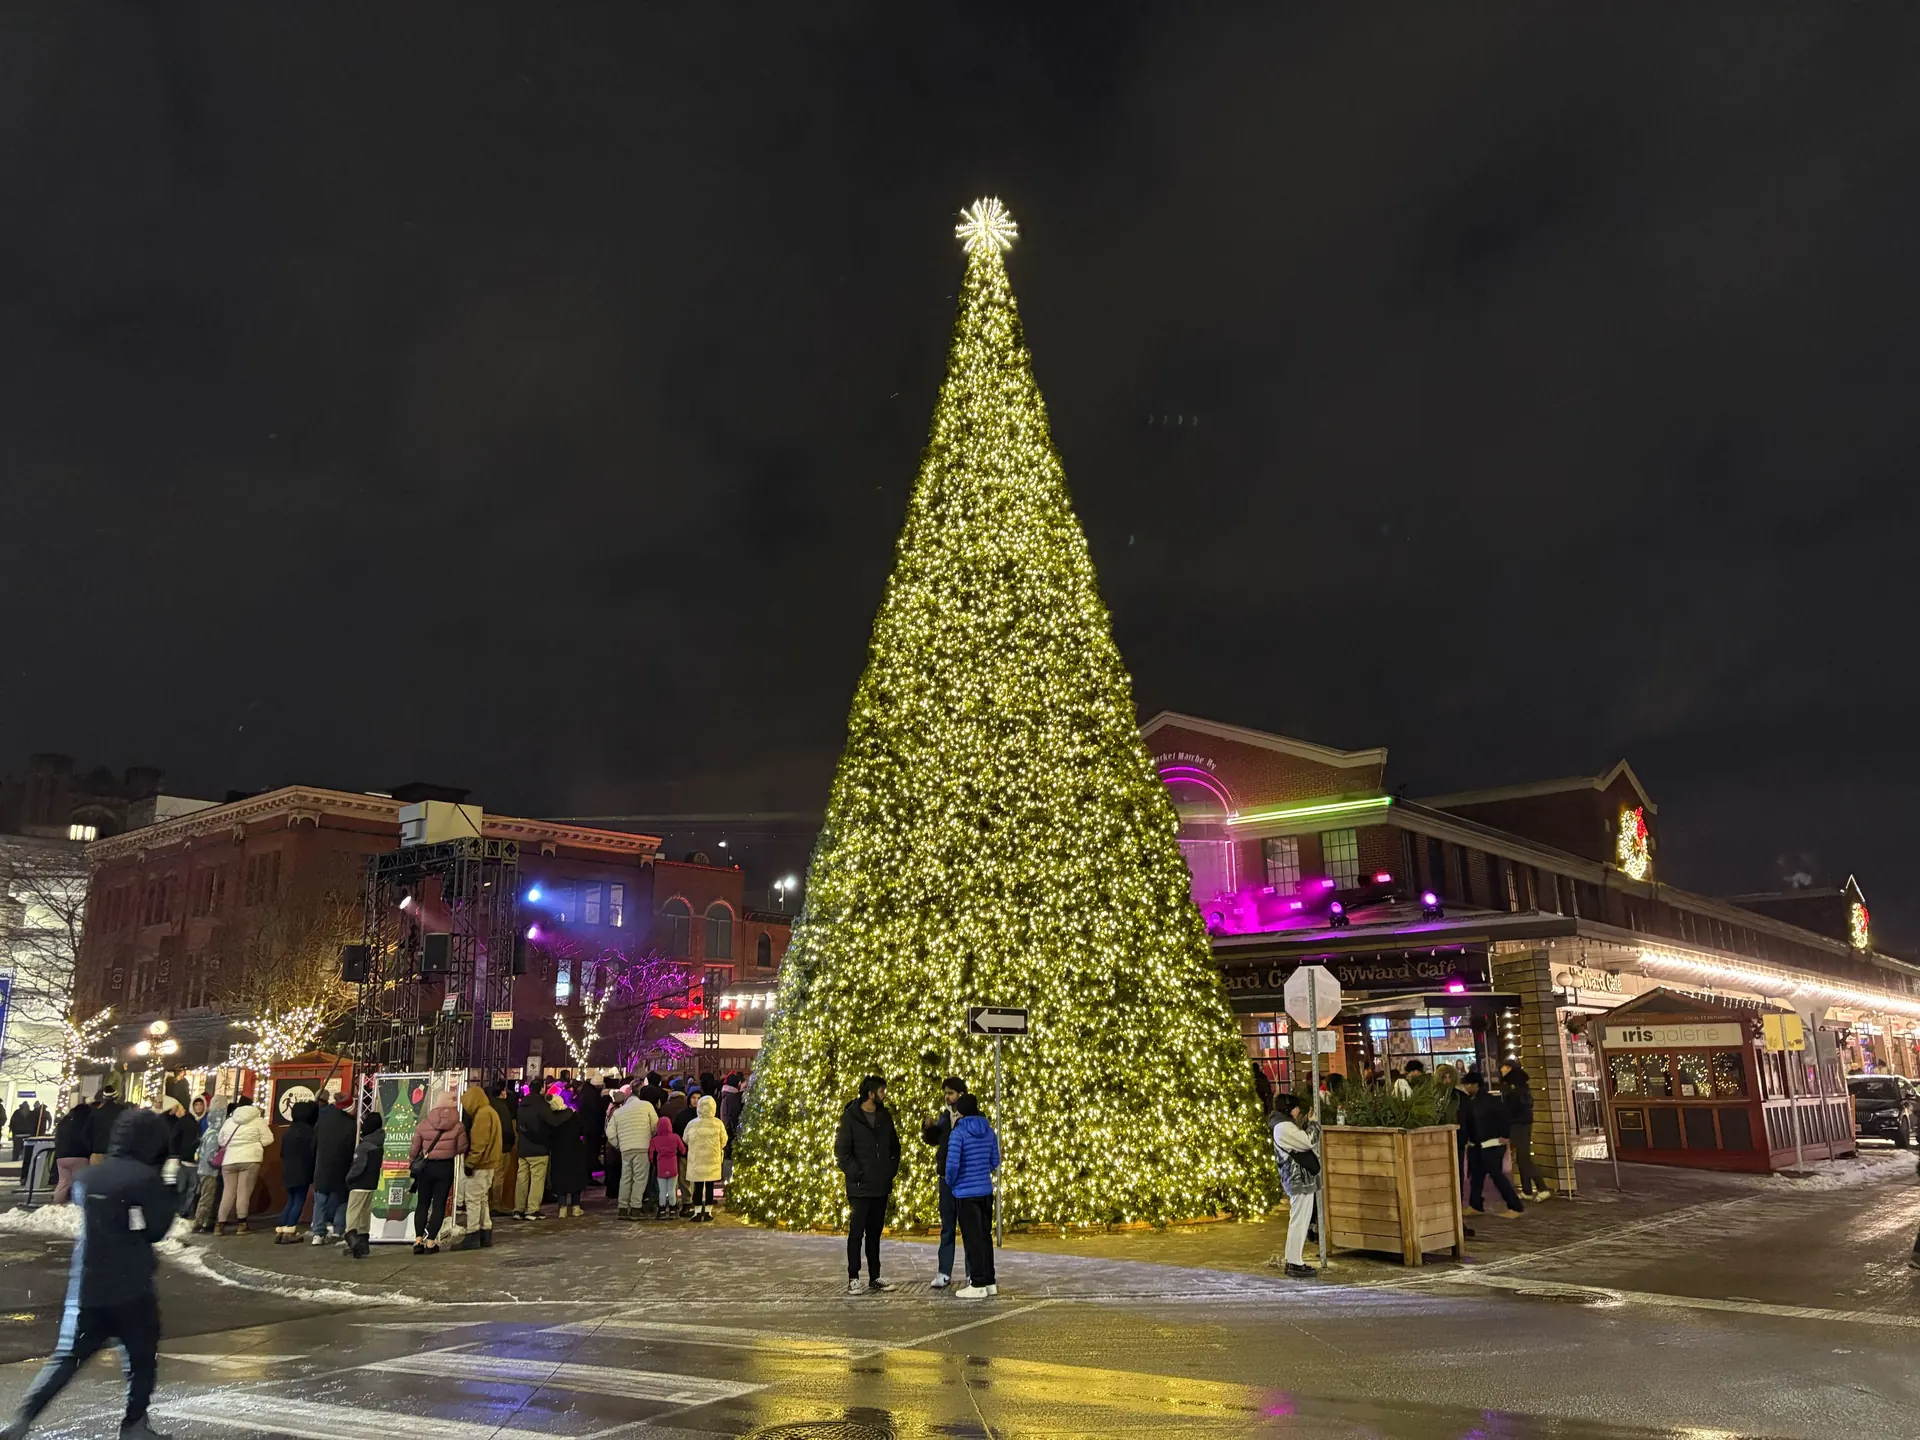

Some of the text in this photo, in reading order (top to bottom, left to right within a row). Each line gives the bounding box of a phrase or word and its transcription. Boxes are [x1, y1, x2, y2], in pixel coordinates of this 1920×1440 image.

[1154, 752, 1176, 763] arket
[1338, 960, 1457, 987] ByWard Café
